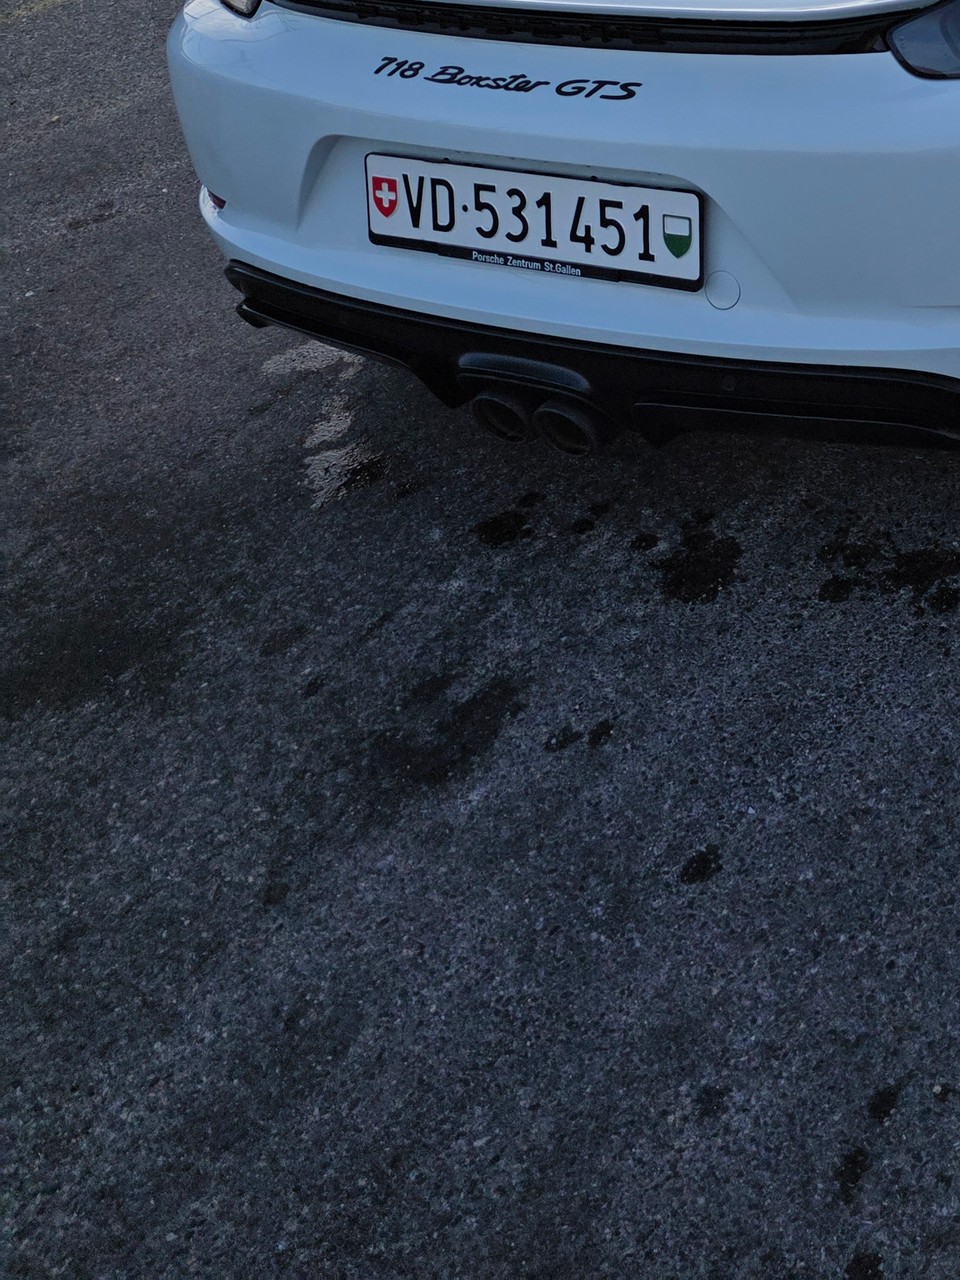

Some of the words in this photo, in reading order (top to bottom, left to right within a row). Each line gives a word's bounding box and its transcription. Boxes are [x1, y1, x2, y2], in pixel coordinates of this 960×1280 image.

[374, 56, 425, 79] 718
[424, 65, 550, 93] Boxster
[555, 79, 643, 100] GTS
[472, 250, 505, 265] Porsche
[507, 256, 541, 270] Zentrum
[544, 261, 581, 276] St.Gallen
